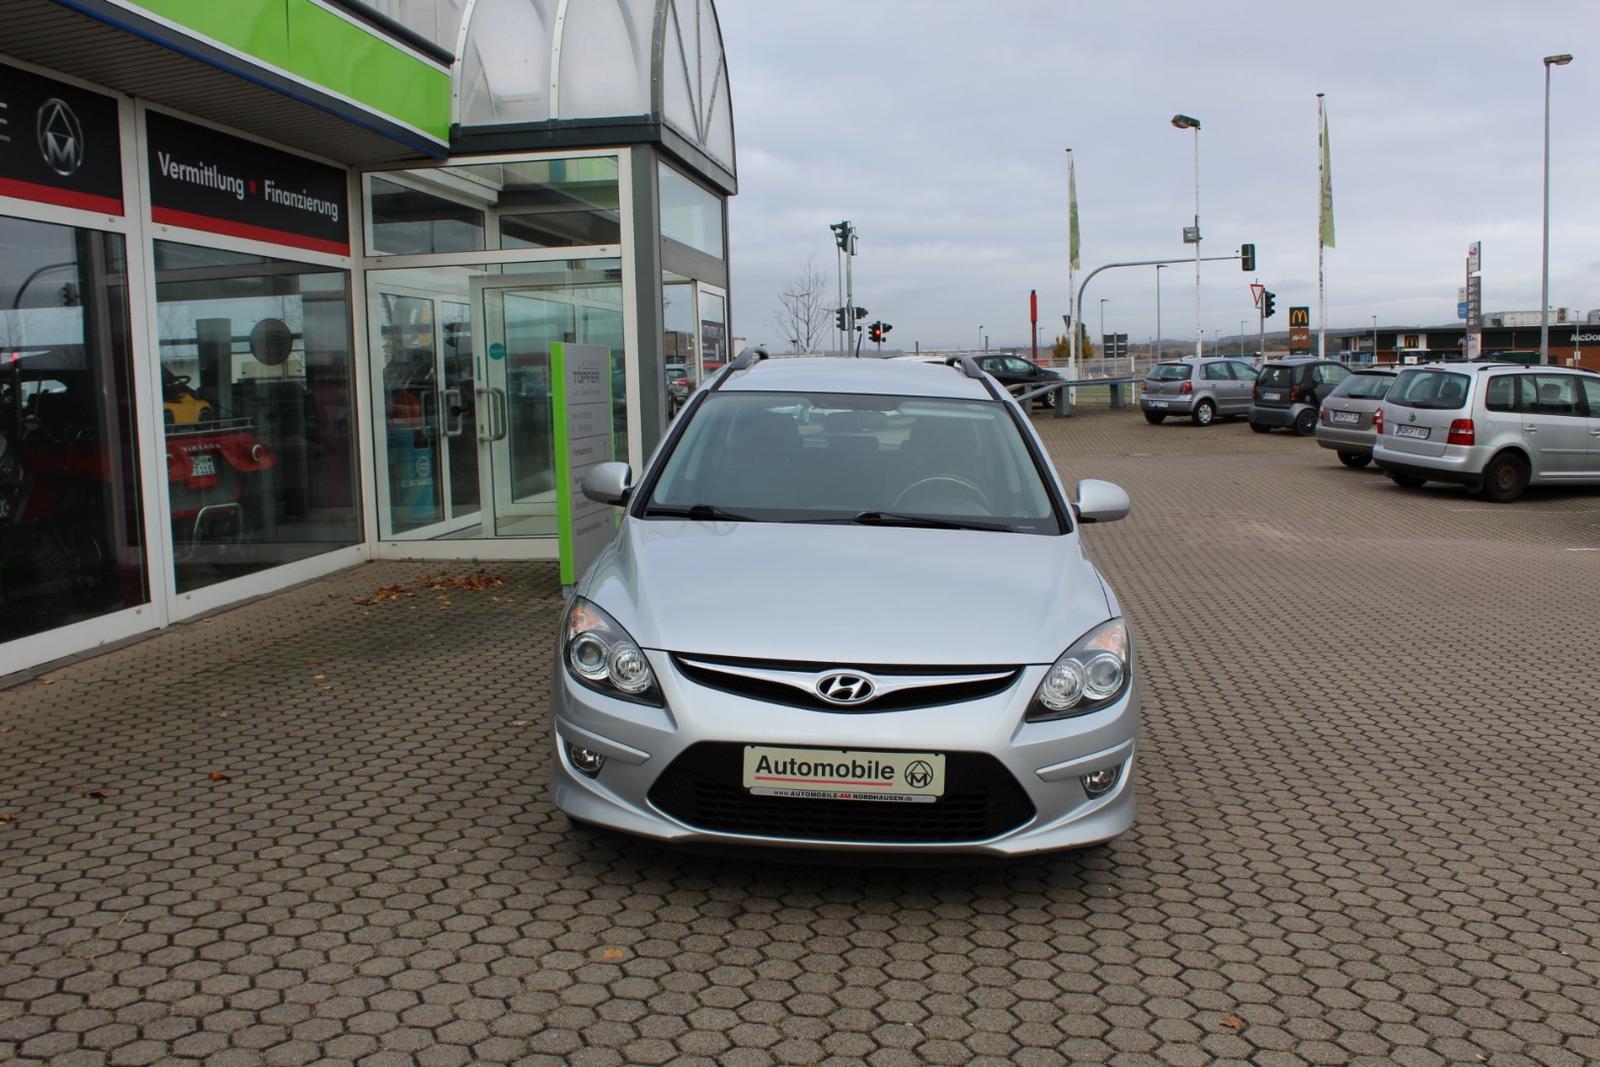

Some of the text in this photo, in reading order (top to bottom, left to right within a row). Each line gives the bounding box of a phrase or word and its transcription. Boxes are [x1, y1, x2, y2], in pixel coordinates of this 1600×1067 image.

[158, 151, 338, 222] Vermittlung Finanzierung
[755, 755, 895, 780] Automobile
